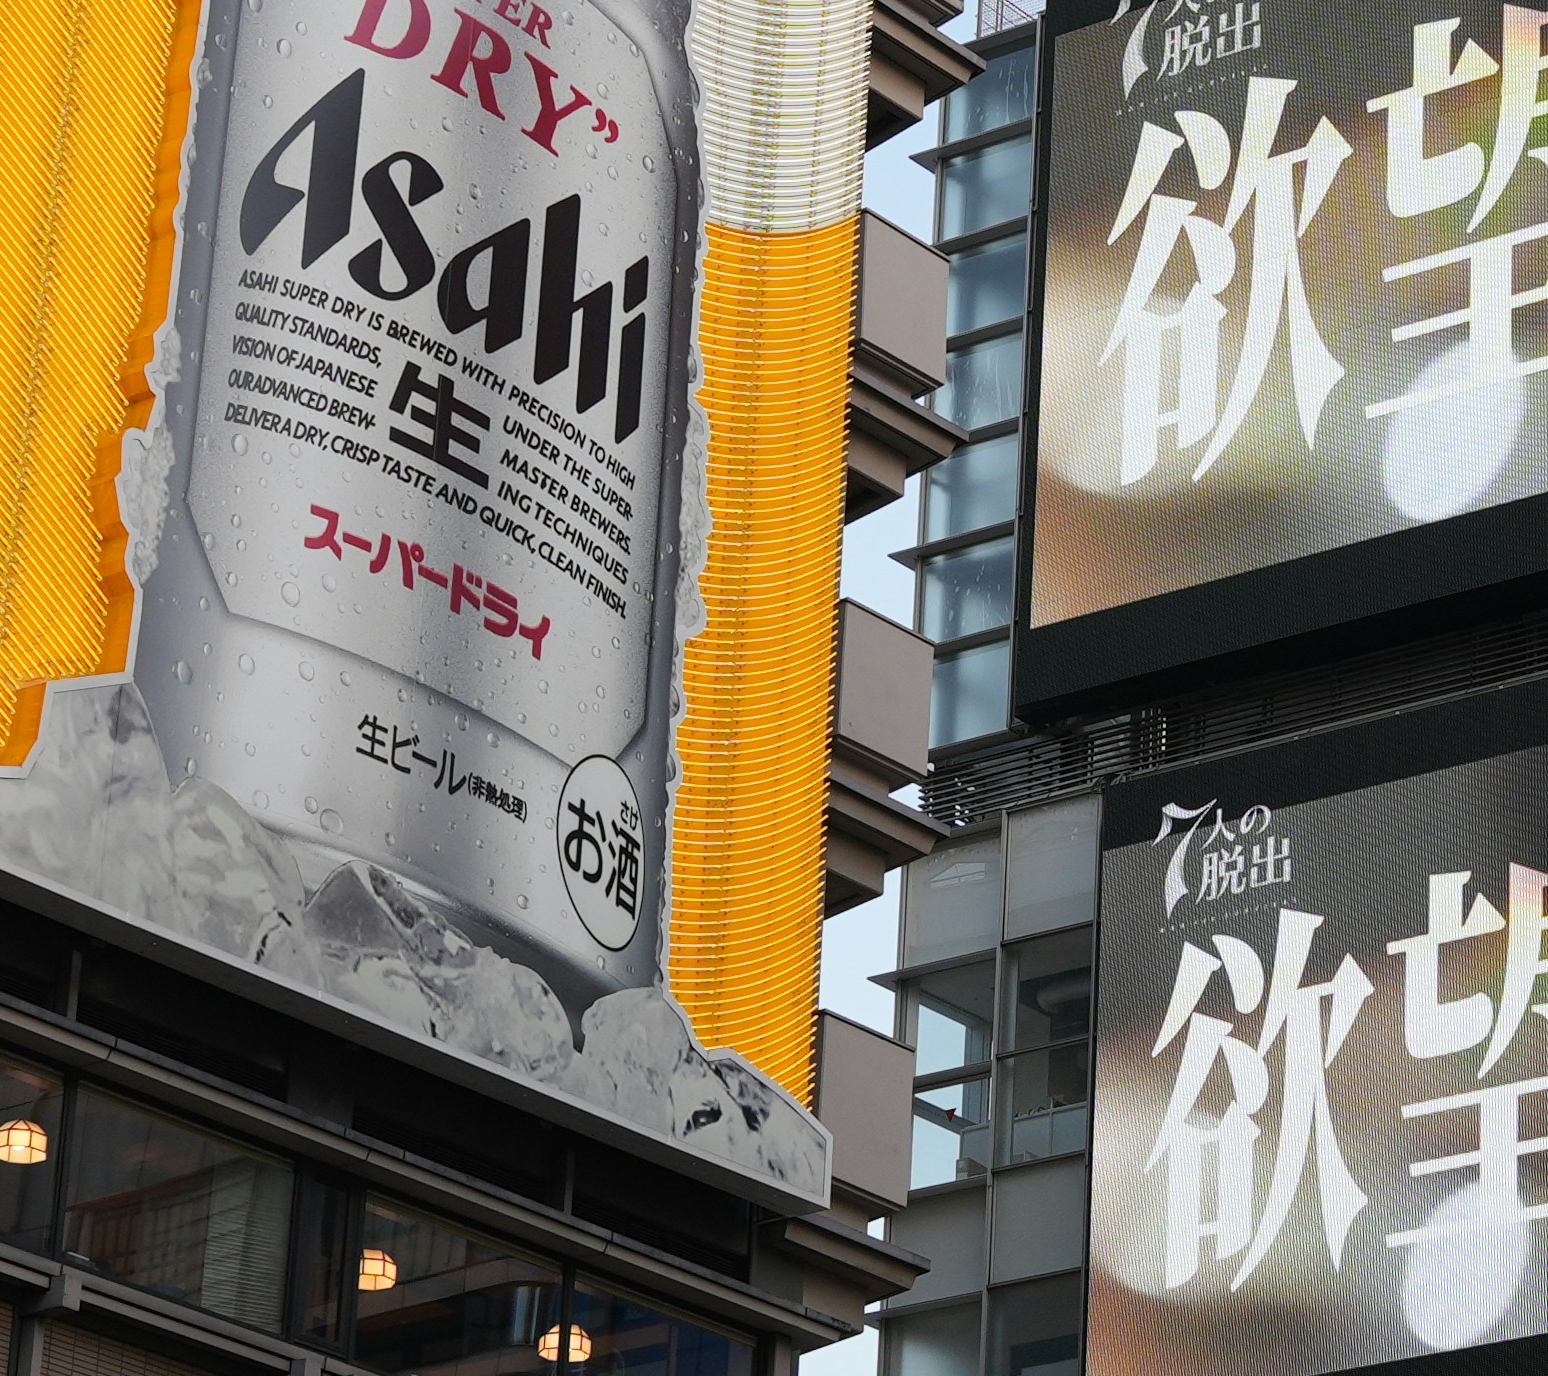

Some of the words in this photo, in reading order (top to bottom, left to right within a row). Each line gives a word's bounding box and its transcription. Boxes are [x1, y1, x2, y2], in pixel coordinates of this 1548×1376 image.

[238, 67, 649, 446] Asahi
[231, 334, 277, 363] VISION
[276, 347, 298, 368] OF
[296, 351, 378, 398] JAPANESE
[235, 301, 291, 334] QUALITY
[288, 316, 383, 368] STANDARDS,
[238, 268, 278, 293] ASAHI
[280, 280, 330, 314] SUPER
[331, 296, 365, 322] DRY
[367, 310, 384, 331] IS
[387, 320, 458, 368] BREWED
[461, 356, 506, 396] WITH
[508, 387, 587, 449] PRECISION
[588, 440, 606, 466] TO
[606, 455, 636, 491] HIGH
[228, 368, 253, 390] OUR
[252, 376, 329, 412] ADVANCED
[327, 400, 376, 431] BREW-
[389, 360, 491, 492] 生
[502, 415, 560, 466] UNDER
[563, 455, 591, 487] THE
[224, 402, 281, 434] DELIVER
[291, 422, 330, 451] DRY,
[331, 435, 380, 467] CRISP
[381, 454, 435, 494] TASTE
[435, 481, 478, 516] AND
[478, 505, 537, 555] QUICK,
[537, 540, 587, 585] CLEAN
[499, 450, 568, 504] MASTER
[303, 503, 551, 661] スーパードライ
[497, 481, 532, 516] ING
[534, 504, 629, 585] TECHNIQUES
[564, 799, 641, 922] お酒
[619, 798, 639, 831] さけ
